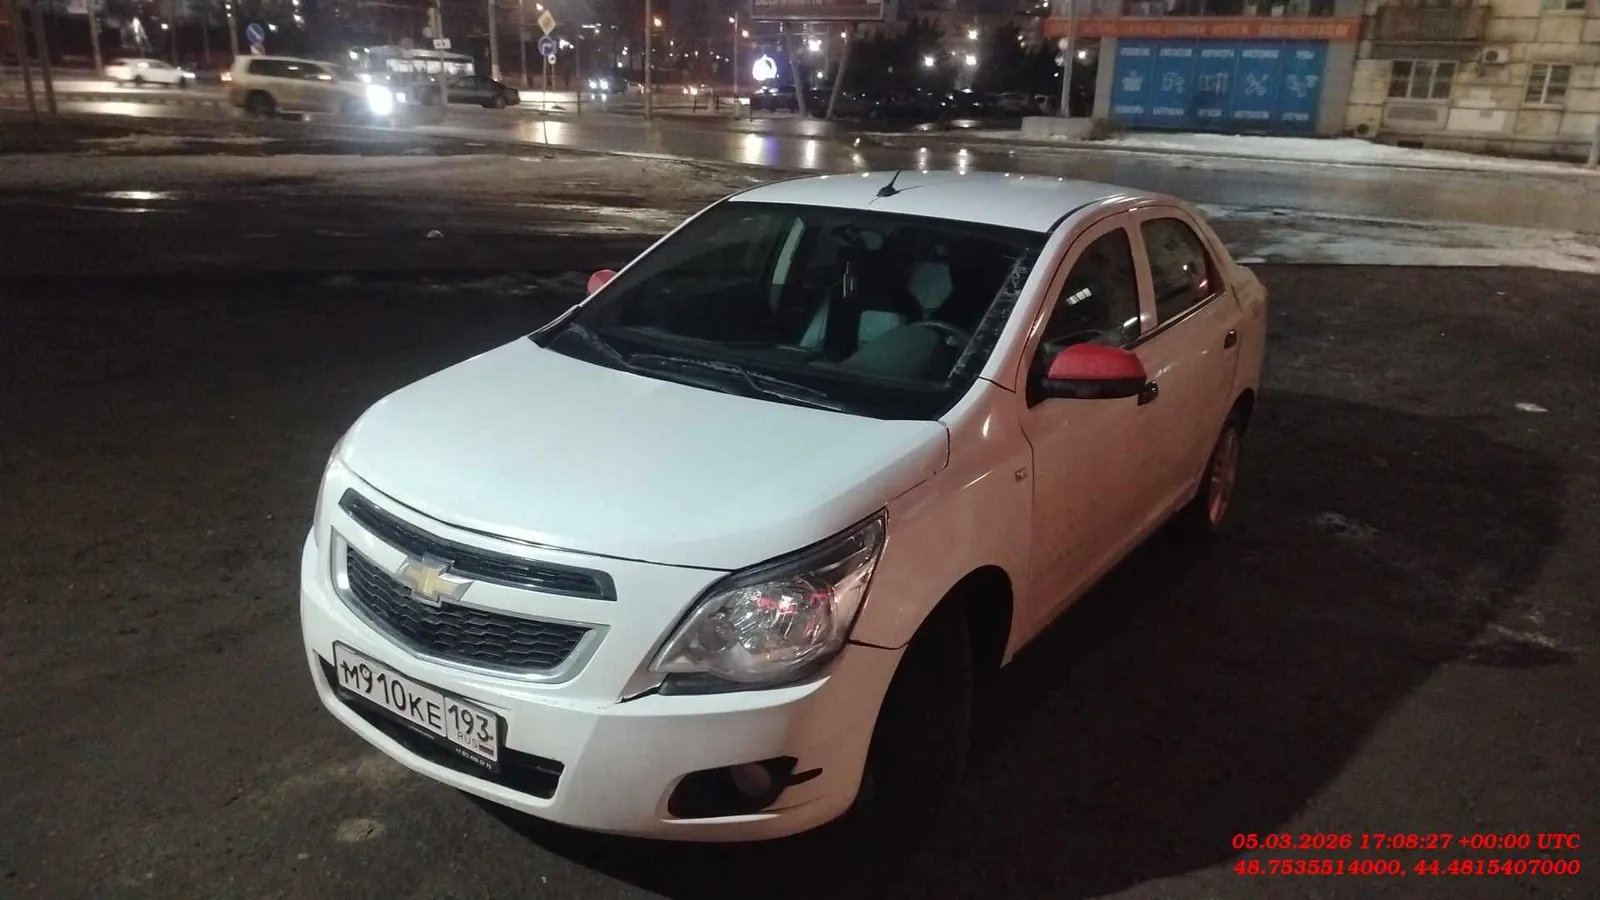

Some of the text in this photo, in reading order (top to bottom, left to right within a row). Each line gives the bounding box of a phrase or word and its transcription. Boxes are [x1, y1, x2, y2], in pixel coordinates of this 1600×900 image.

[340, 659, 490, 743] М910КЕ 193
[457, 731, 480, 749] RUS
